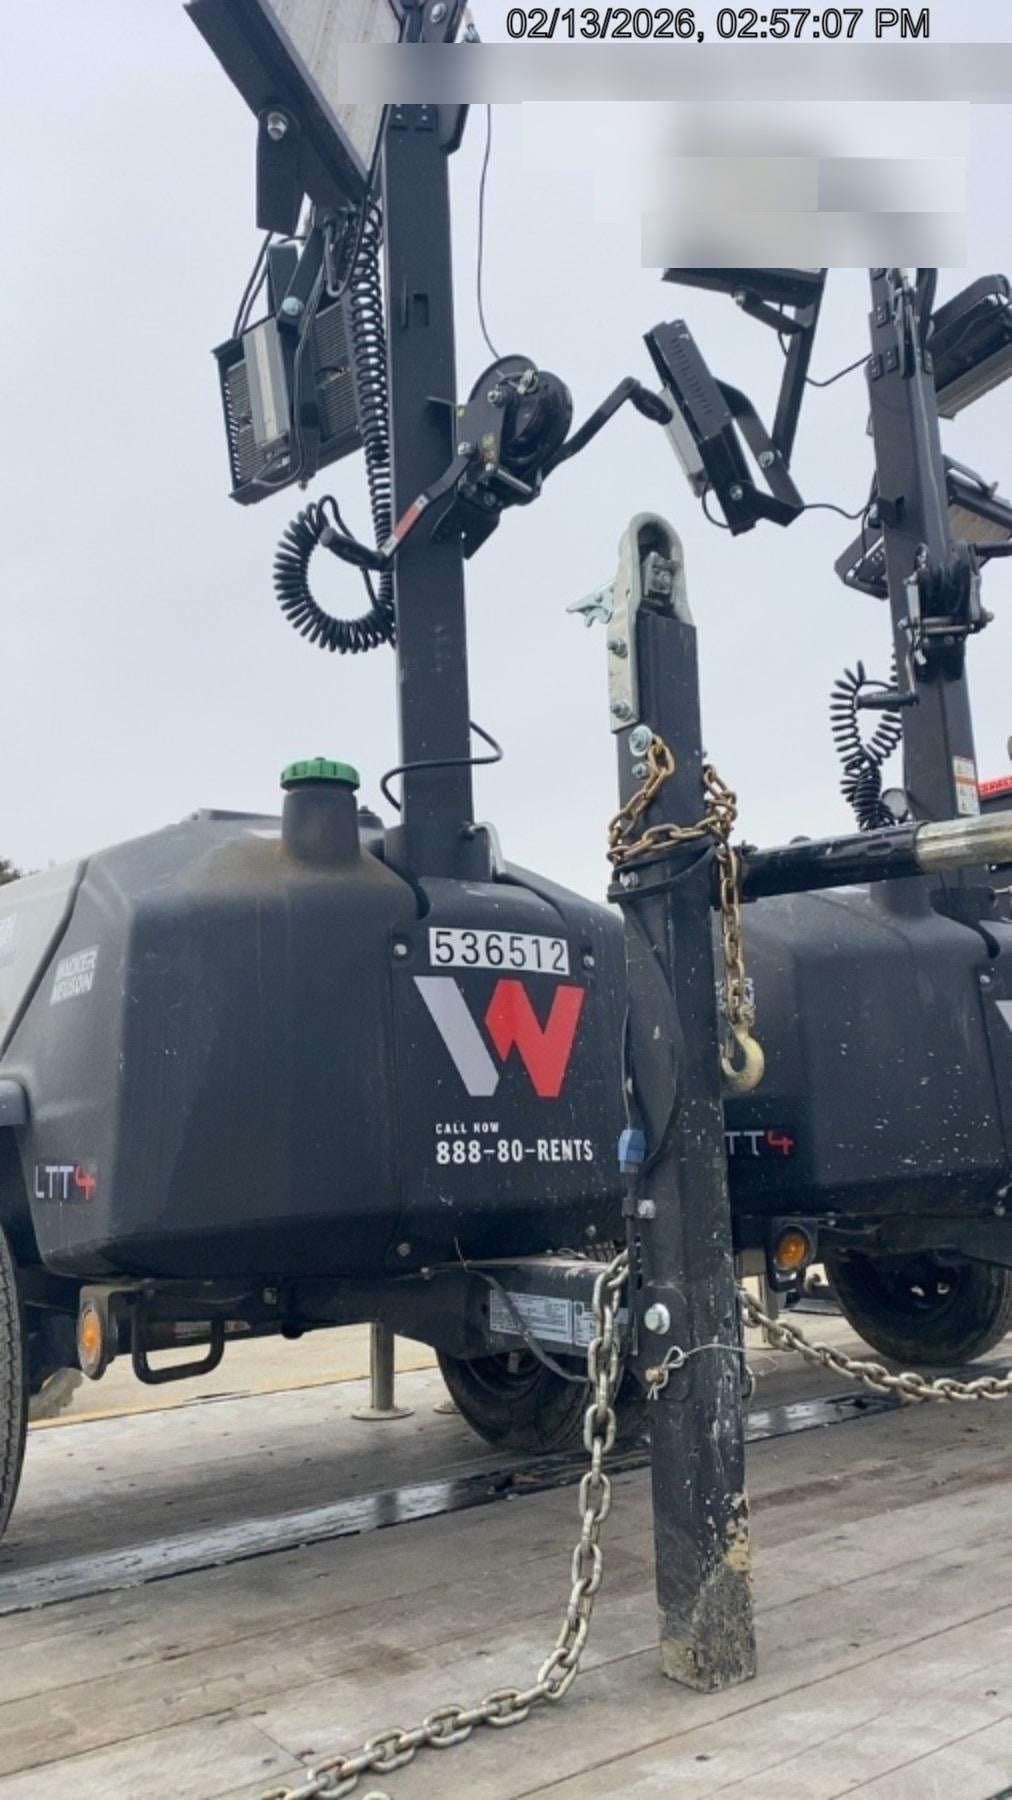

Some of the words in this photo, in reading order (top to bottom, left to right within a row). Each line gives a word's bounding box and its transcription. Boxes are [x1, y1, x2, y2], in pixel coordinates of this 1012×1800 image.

[434, 930, 567, 973] 536512
[435, 1122, 467, 1134] CALL
[473, 1121, 500, 1133] NOW
[435, 1139, 594, 1165] 888-80-RENTS
[723, 1130, 795, 1156] TT4
[35, 1164, 96, 1201] LTT4
